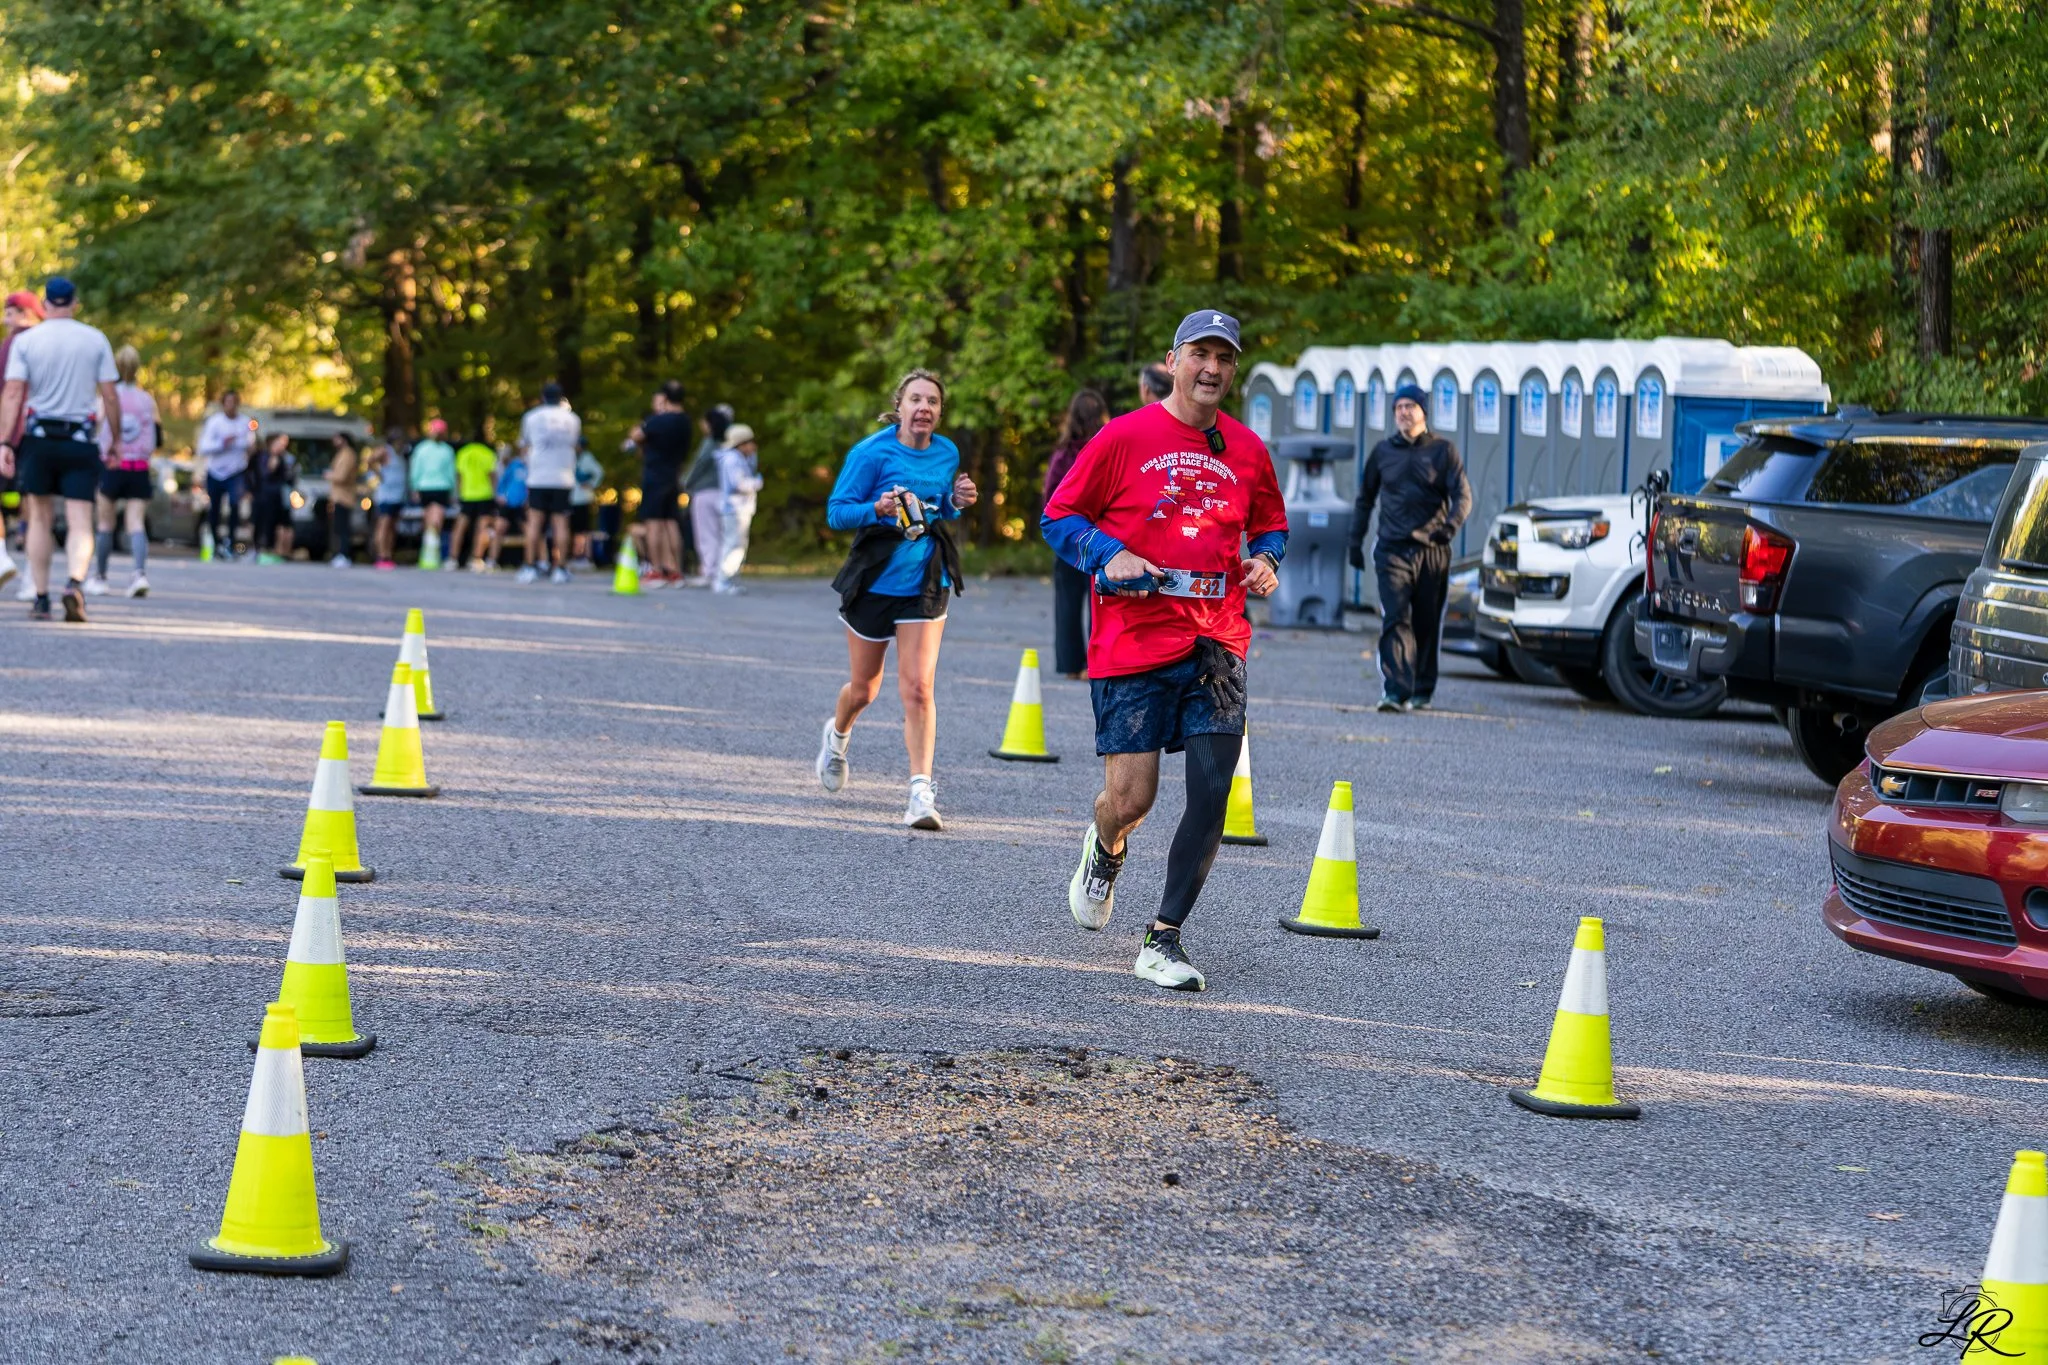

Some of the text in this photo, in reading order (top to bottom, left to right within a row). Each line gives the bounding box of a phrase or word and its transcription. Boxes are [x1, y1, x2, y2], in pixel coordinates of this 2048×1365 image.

[1140, 457, 1158, 474] 2024
[1158, 452, 1179, 462] LANE
[1180, 451, 1208, 462] PURSER
[1209, 457, 1238, 485] MEMORIAL
[1154, 458, 1178, 471] ROAD
[1180, 458, 1201, 467] RACE
[1202, 462, 1228, 480] SERIES
[1188, 578, 1220, 596] 432
[1975, 789, 1999, 798] RS
